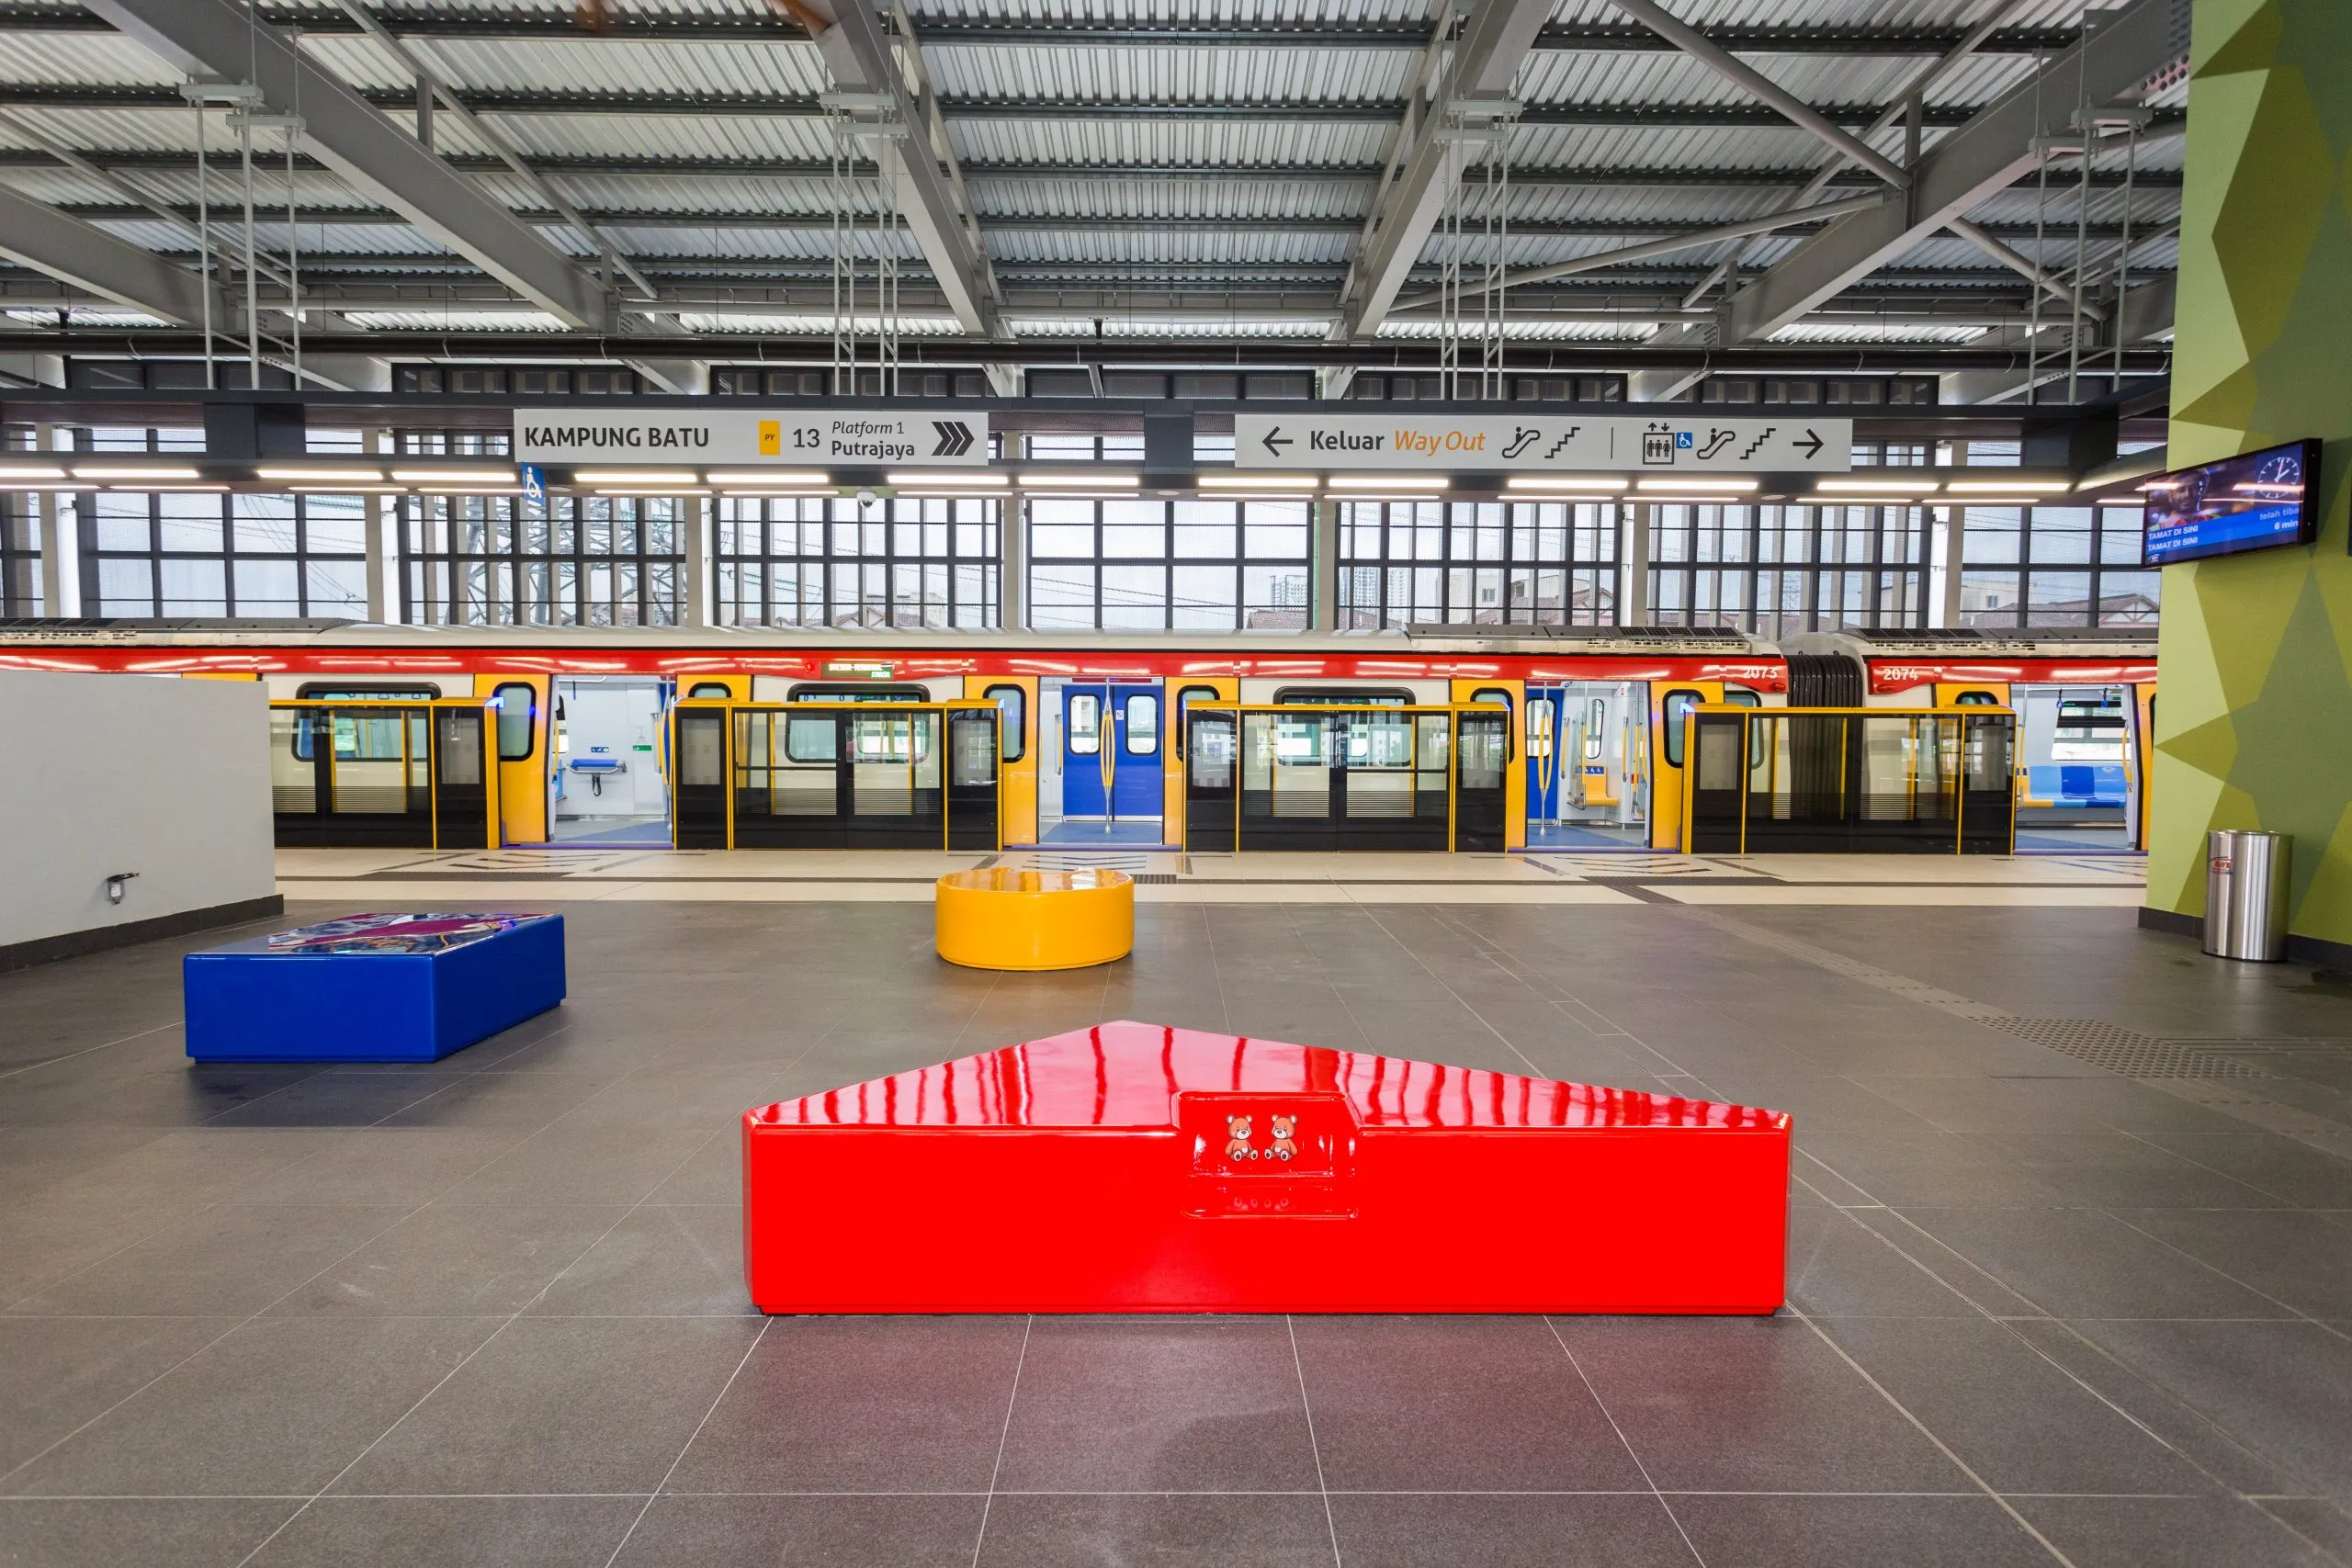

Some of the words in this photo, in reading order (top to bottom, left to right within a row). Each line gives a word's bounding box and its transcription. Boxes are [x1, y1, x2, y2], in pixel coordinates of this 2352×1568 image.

[525, 426, 641, 447] KAMPUNG
[648, 427, 709, 447] BATU
[831, 421, 892, 437] Platform
[897, 422, 905, 434] 1
[764, 433, 775, 442] PY
[793, 428, 820, 448] 13
[1310, 430, 1385, 451] Keluar
[1395, 429, 1442, 457] Way
[1444, 430, 1486, 452] Out
[831, 440, 915, 460] Putrajaya
[2281, 519, 2299, 529] min
[2148, 529, 2173, 541] TAMAT
[2174, 527, 2182, 536] DI
[2183, 525, 2199, 534] SINI
[2147, 540, 2172, 551] TAMAT
[2173, 539, 2181, 547] DI
[2182, 536, 2198, 546] SINI
[1743, 667, 1778, 679] 2073
[1883, 668, 1918, 681] 2074
